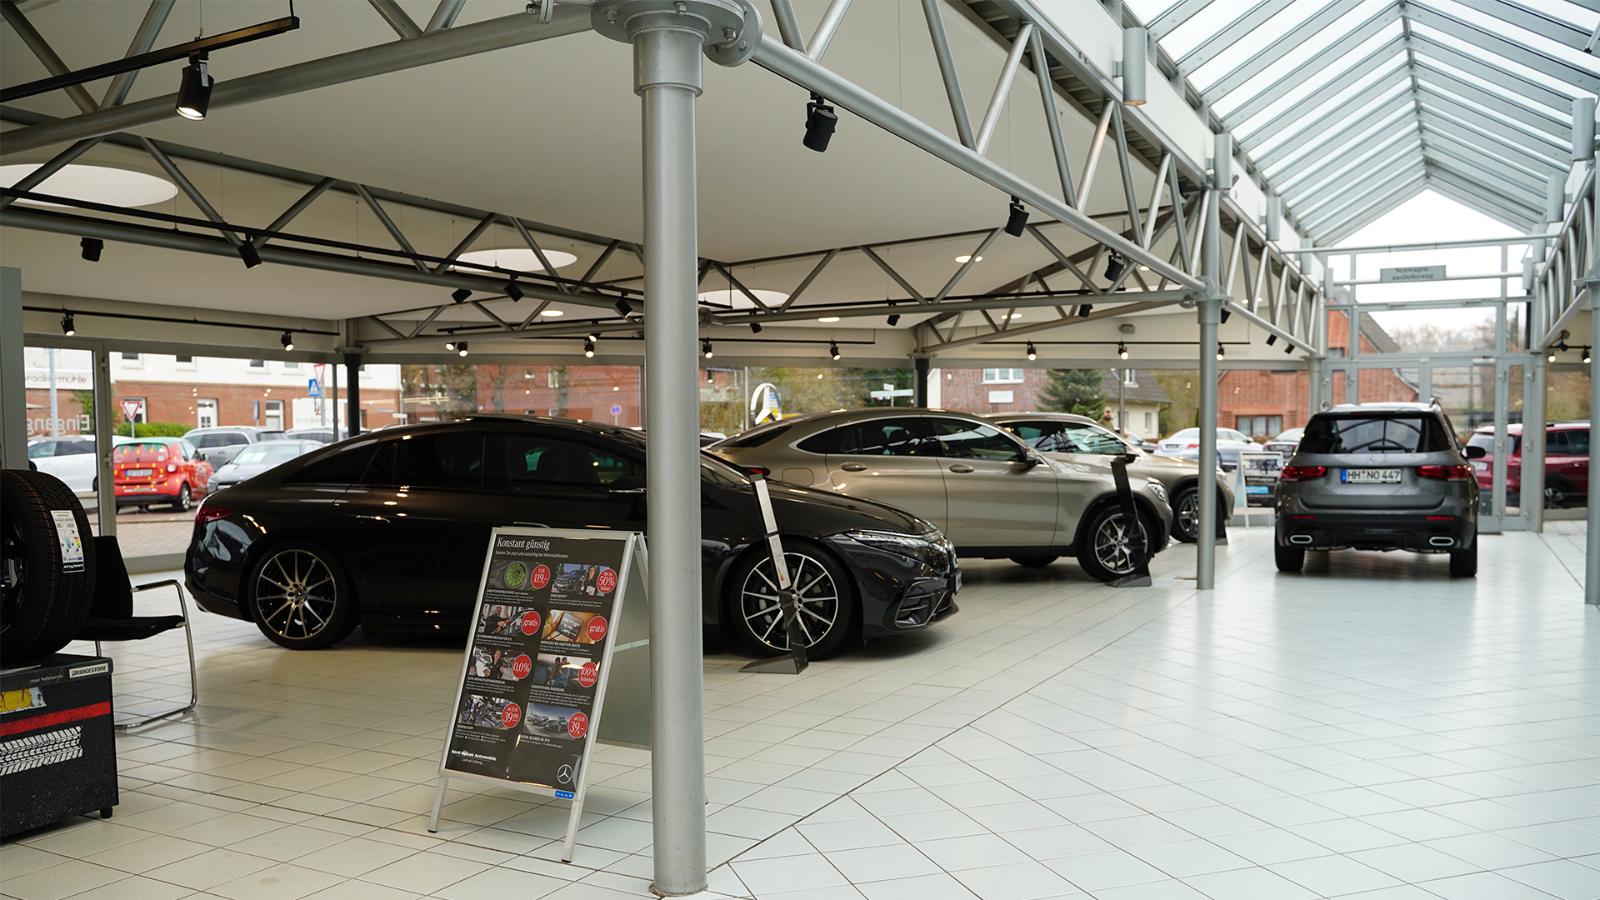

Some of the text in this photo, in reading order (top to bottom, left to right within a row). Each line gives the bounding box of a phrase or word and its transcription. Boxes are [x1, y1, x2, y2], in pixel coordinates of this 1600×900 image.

[1347, 470, 1361, 479] HH
[1382, 470, 1400, 480] 447
[497, 537, 551, 552] Konstant günstig
[523, 618, 538, 627] gratis
[589, 625, 605, 633] gratis
[71, 664, 107, 676] BRIDGESTONE
